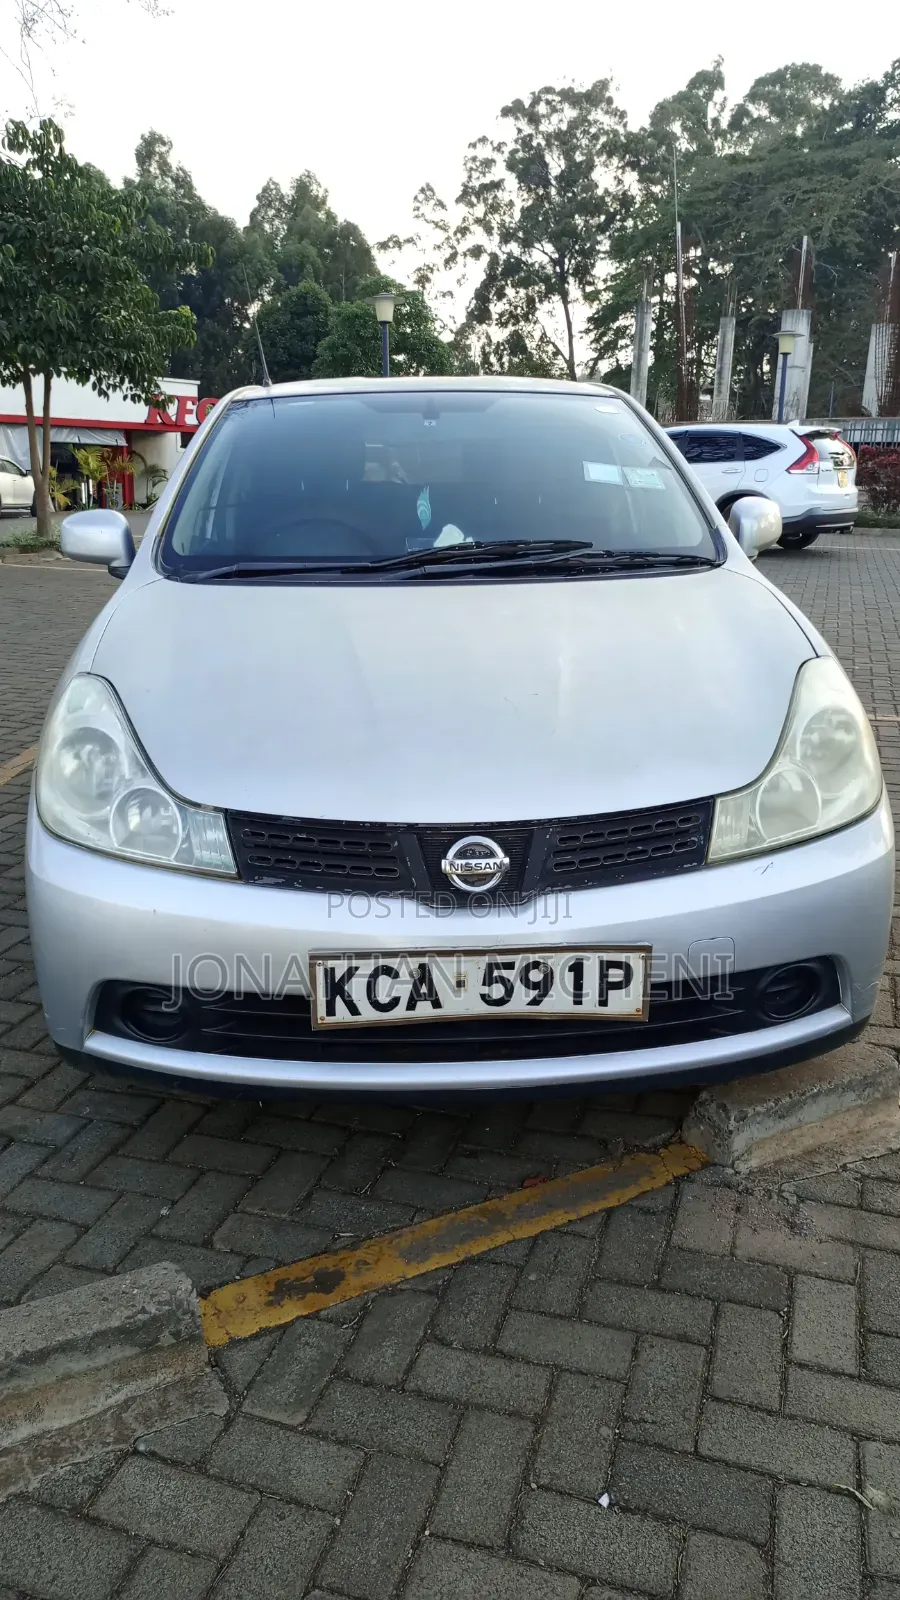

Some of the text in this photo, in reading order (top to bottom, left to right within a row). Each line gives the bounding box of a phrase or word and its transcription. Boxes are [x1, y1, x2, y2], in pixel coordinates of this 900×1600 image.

[449, 861, 503, 873] NISSAN
[324, 957, 634, 1017] KCA 591P
